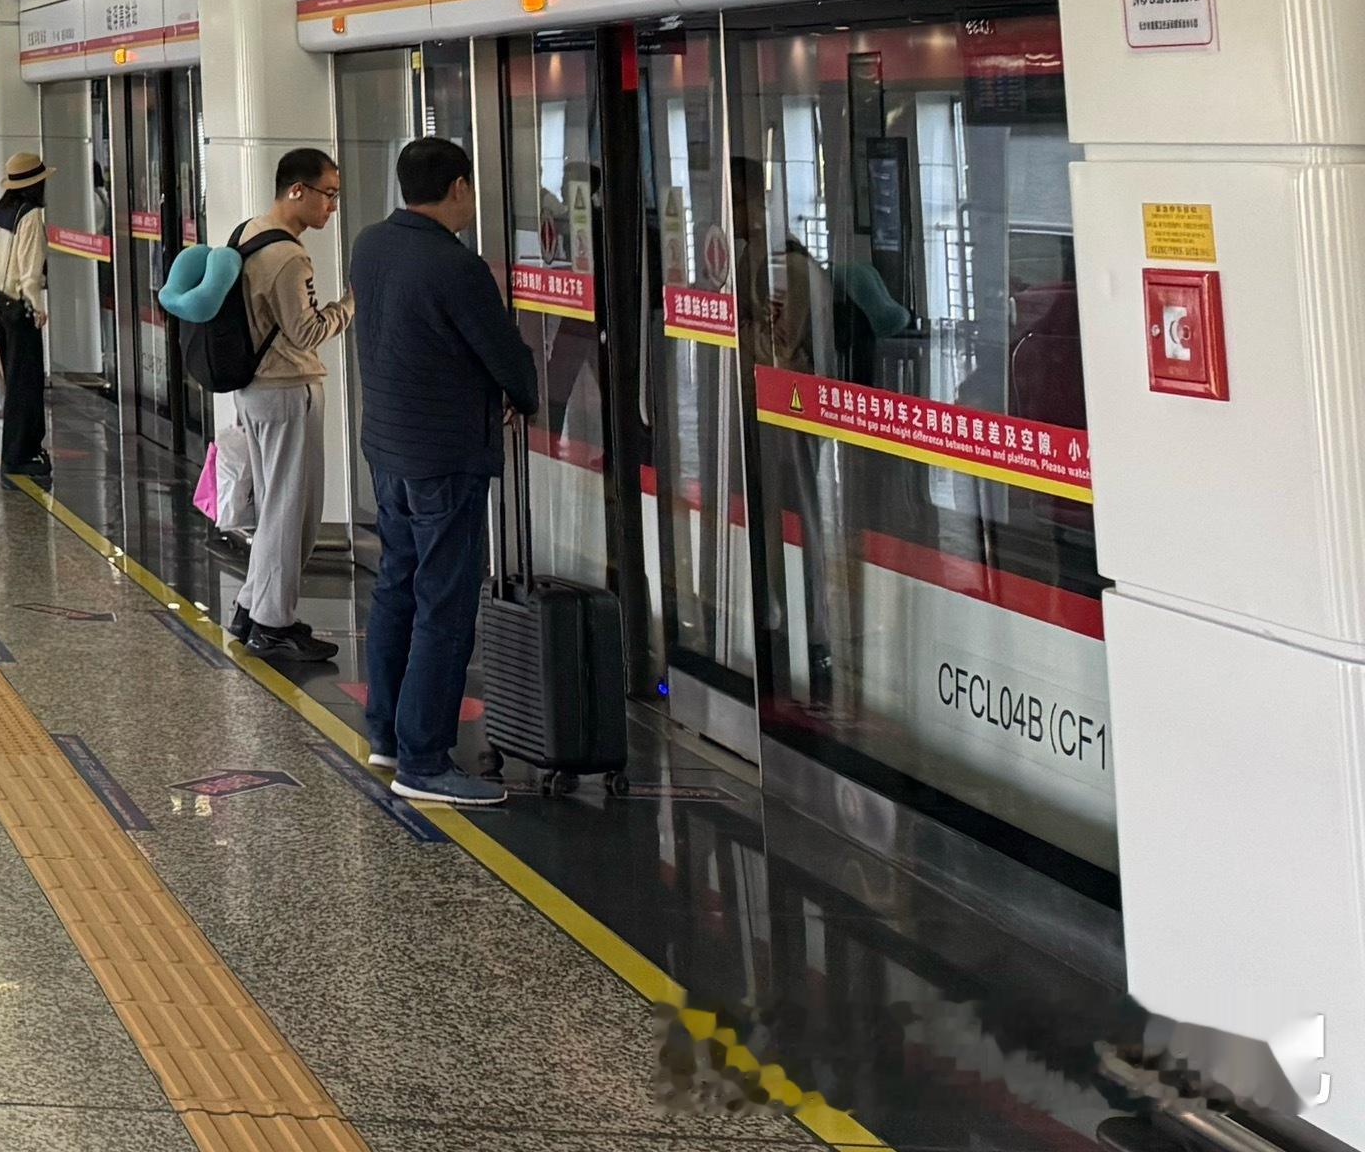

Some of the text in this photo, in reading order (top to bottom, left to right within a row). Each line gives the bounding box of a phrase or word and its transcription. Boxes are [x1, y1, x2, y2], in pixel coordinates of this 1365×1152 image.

[818, 384, 1090, 462] 注意站台与列车之间的高度差及空隙，小
[820, 407, 839, 421] Please
[840, 414, 854, 425] mind
[857, 416, 866, 427] the
[868, 420, 878, 431] gap
[880, 423, 891, 433] and
[892, 425, 911, 439] height
[913, 430, 944, 447] difference
[945, 437, 973, 453] between
[974, 444, 991, 457] train
[993, 450, 1005, 461] and
[1041, 459, 1066, 475] Please
[939, 662, 1106, 770] CFCL04B (CF1
